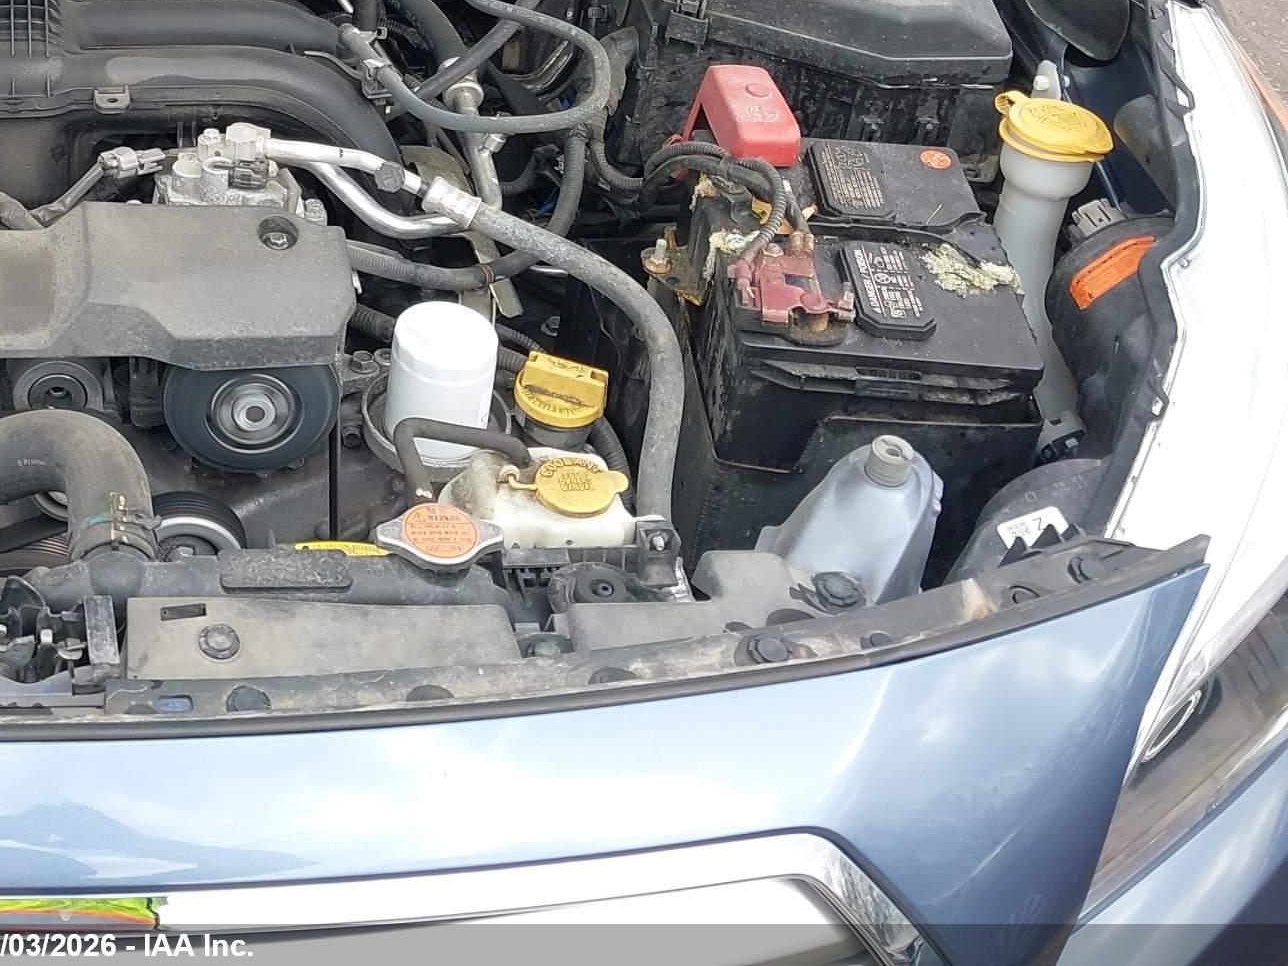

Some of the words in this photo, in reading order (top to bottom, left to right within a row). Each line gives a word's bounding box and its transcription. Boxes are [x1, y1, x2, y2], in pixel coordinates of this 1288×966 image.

[853, 248, 869, 274] POISON
[862, 279, 880, 307] DANGER
[540, 457, 601, 477] COOLANT
